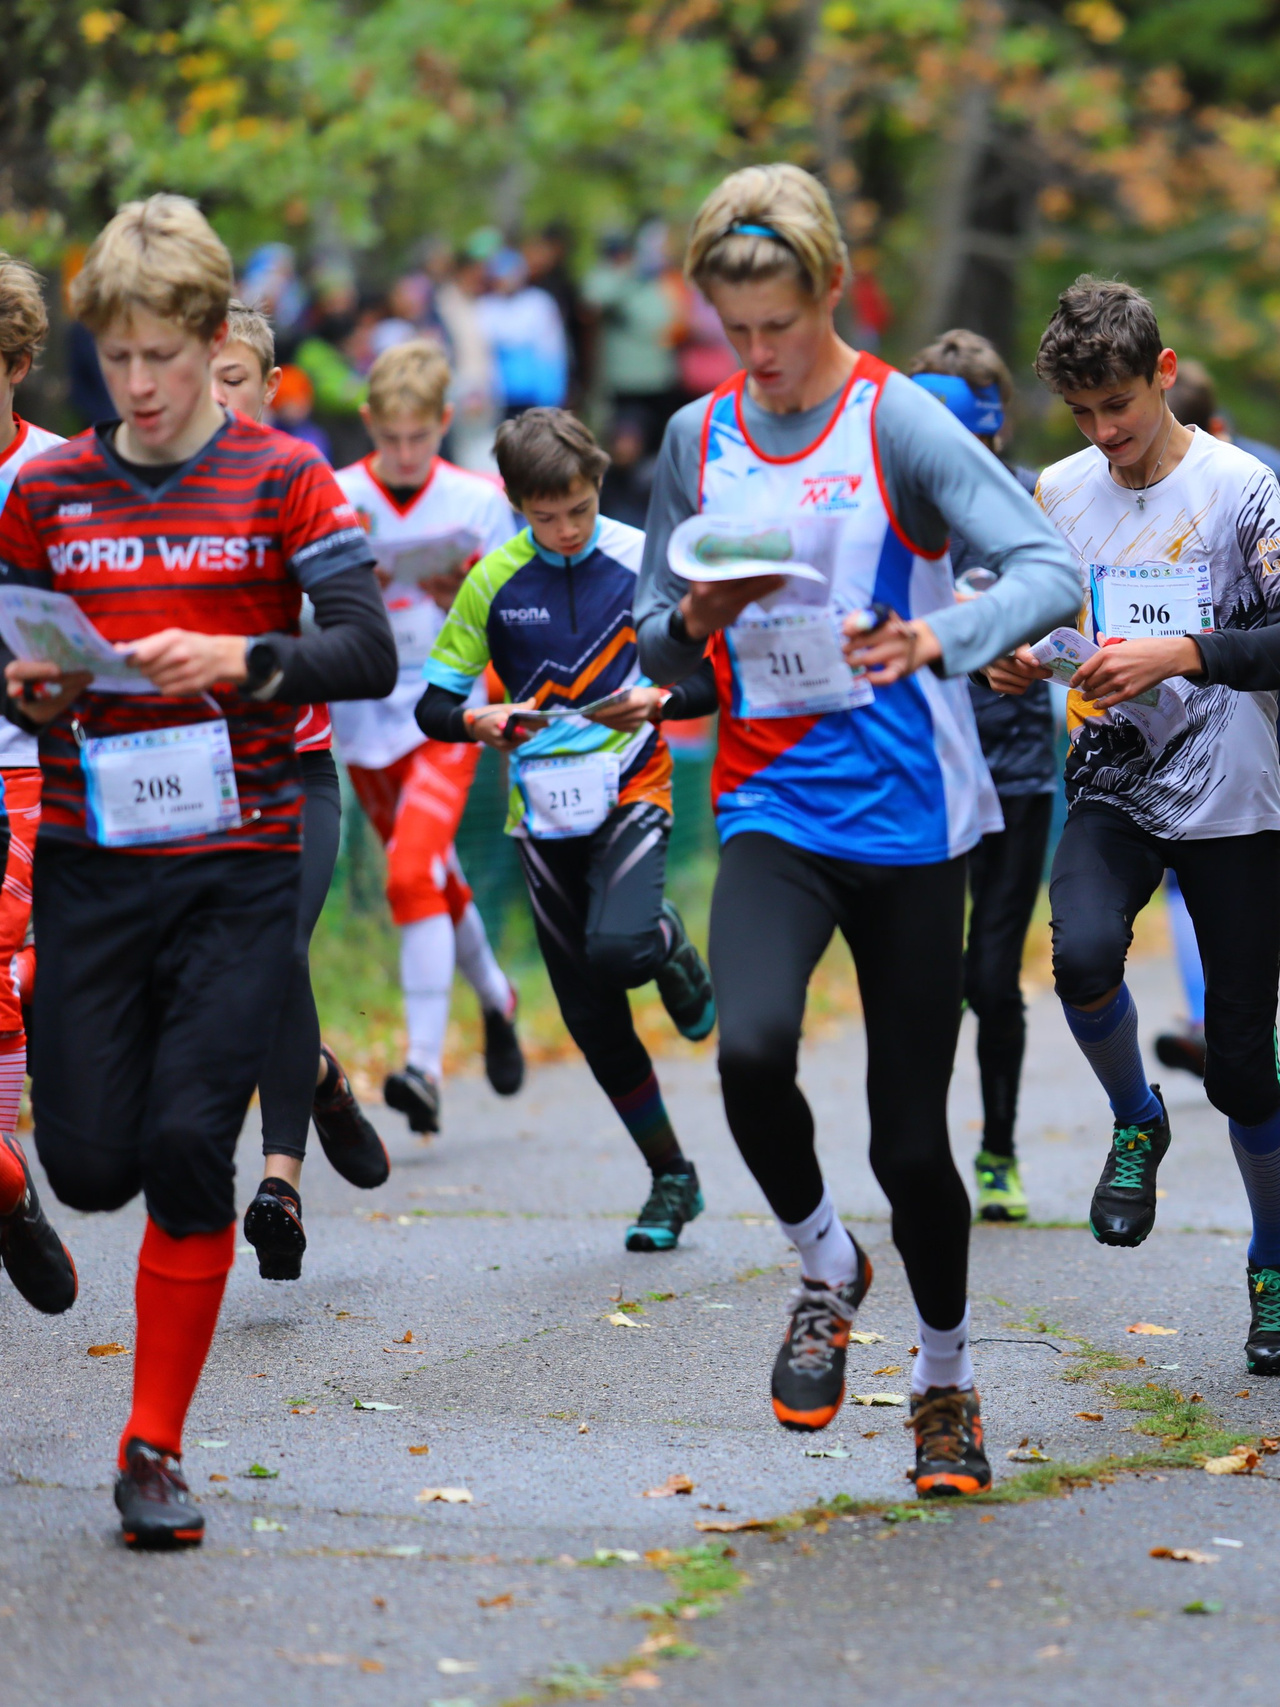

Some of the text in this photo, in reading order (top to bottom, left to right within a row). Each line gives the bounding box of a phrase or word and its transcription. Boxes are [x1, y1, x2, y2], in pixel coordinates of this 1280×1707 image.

[156, 535, 272, 571] WEST
[499, 607, 551, 621] ТРОПА
[1129, 603, 1171, 624] 206
[768, 652, 804, 675] 211
[133, 775, 182, 803] 208
[549, 788, 582, 809] 213
